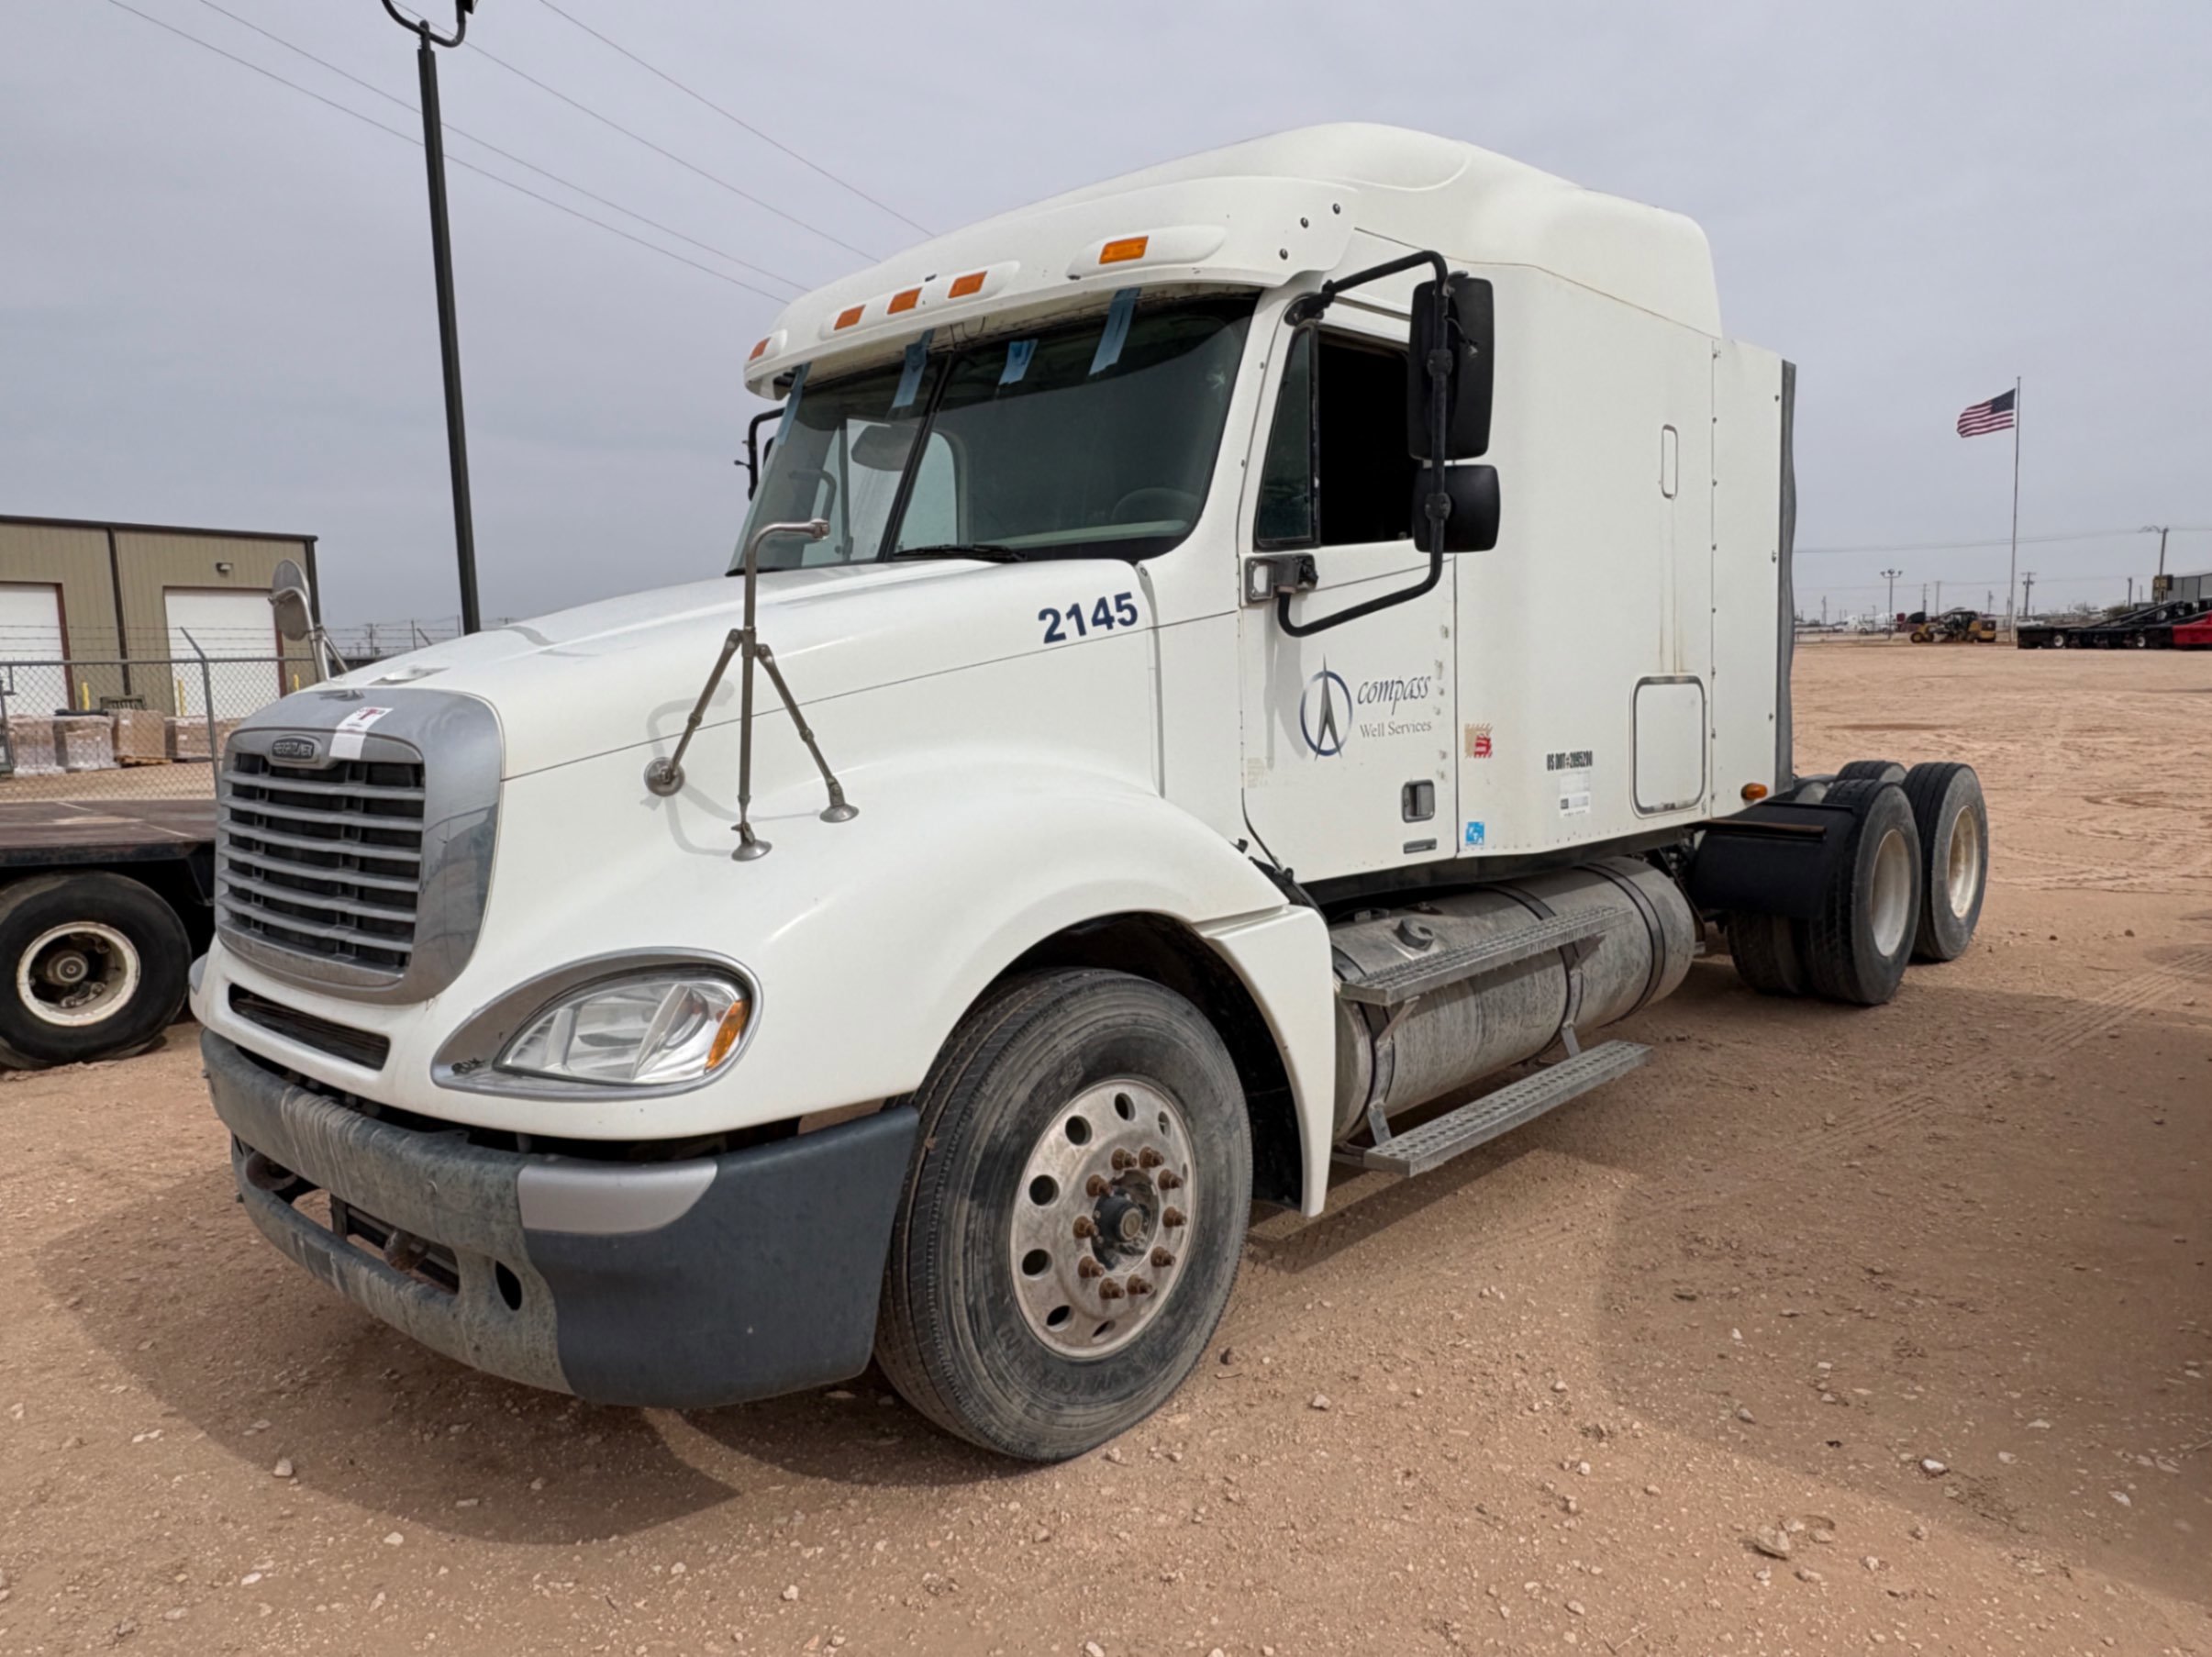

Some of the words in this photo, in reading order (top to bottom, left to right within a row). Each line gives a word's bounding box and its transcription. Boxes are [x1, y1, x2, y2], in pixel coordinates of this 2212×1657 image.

[1039, 592, 1138, 643] 2145
[1358, 675, 1431, 716] compass
[1360, 722, 1384, 738] Well
[1387, 720, 1432, 737] Services
